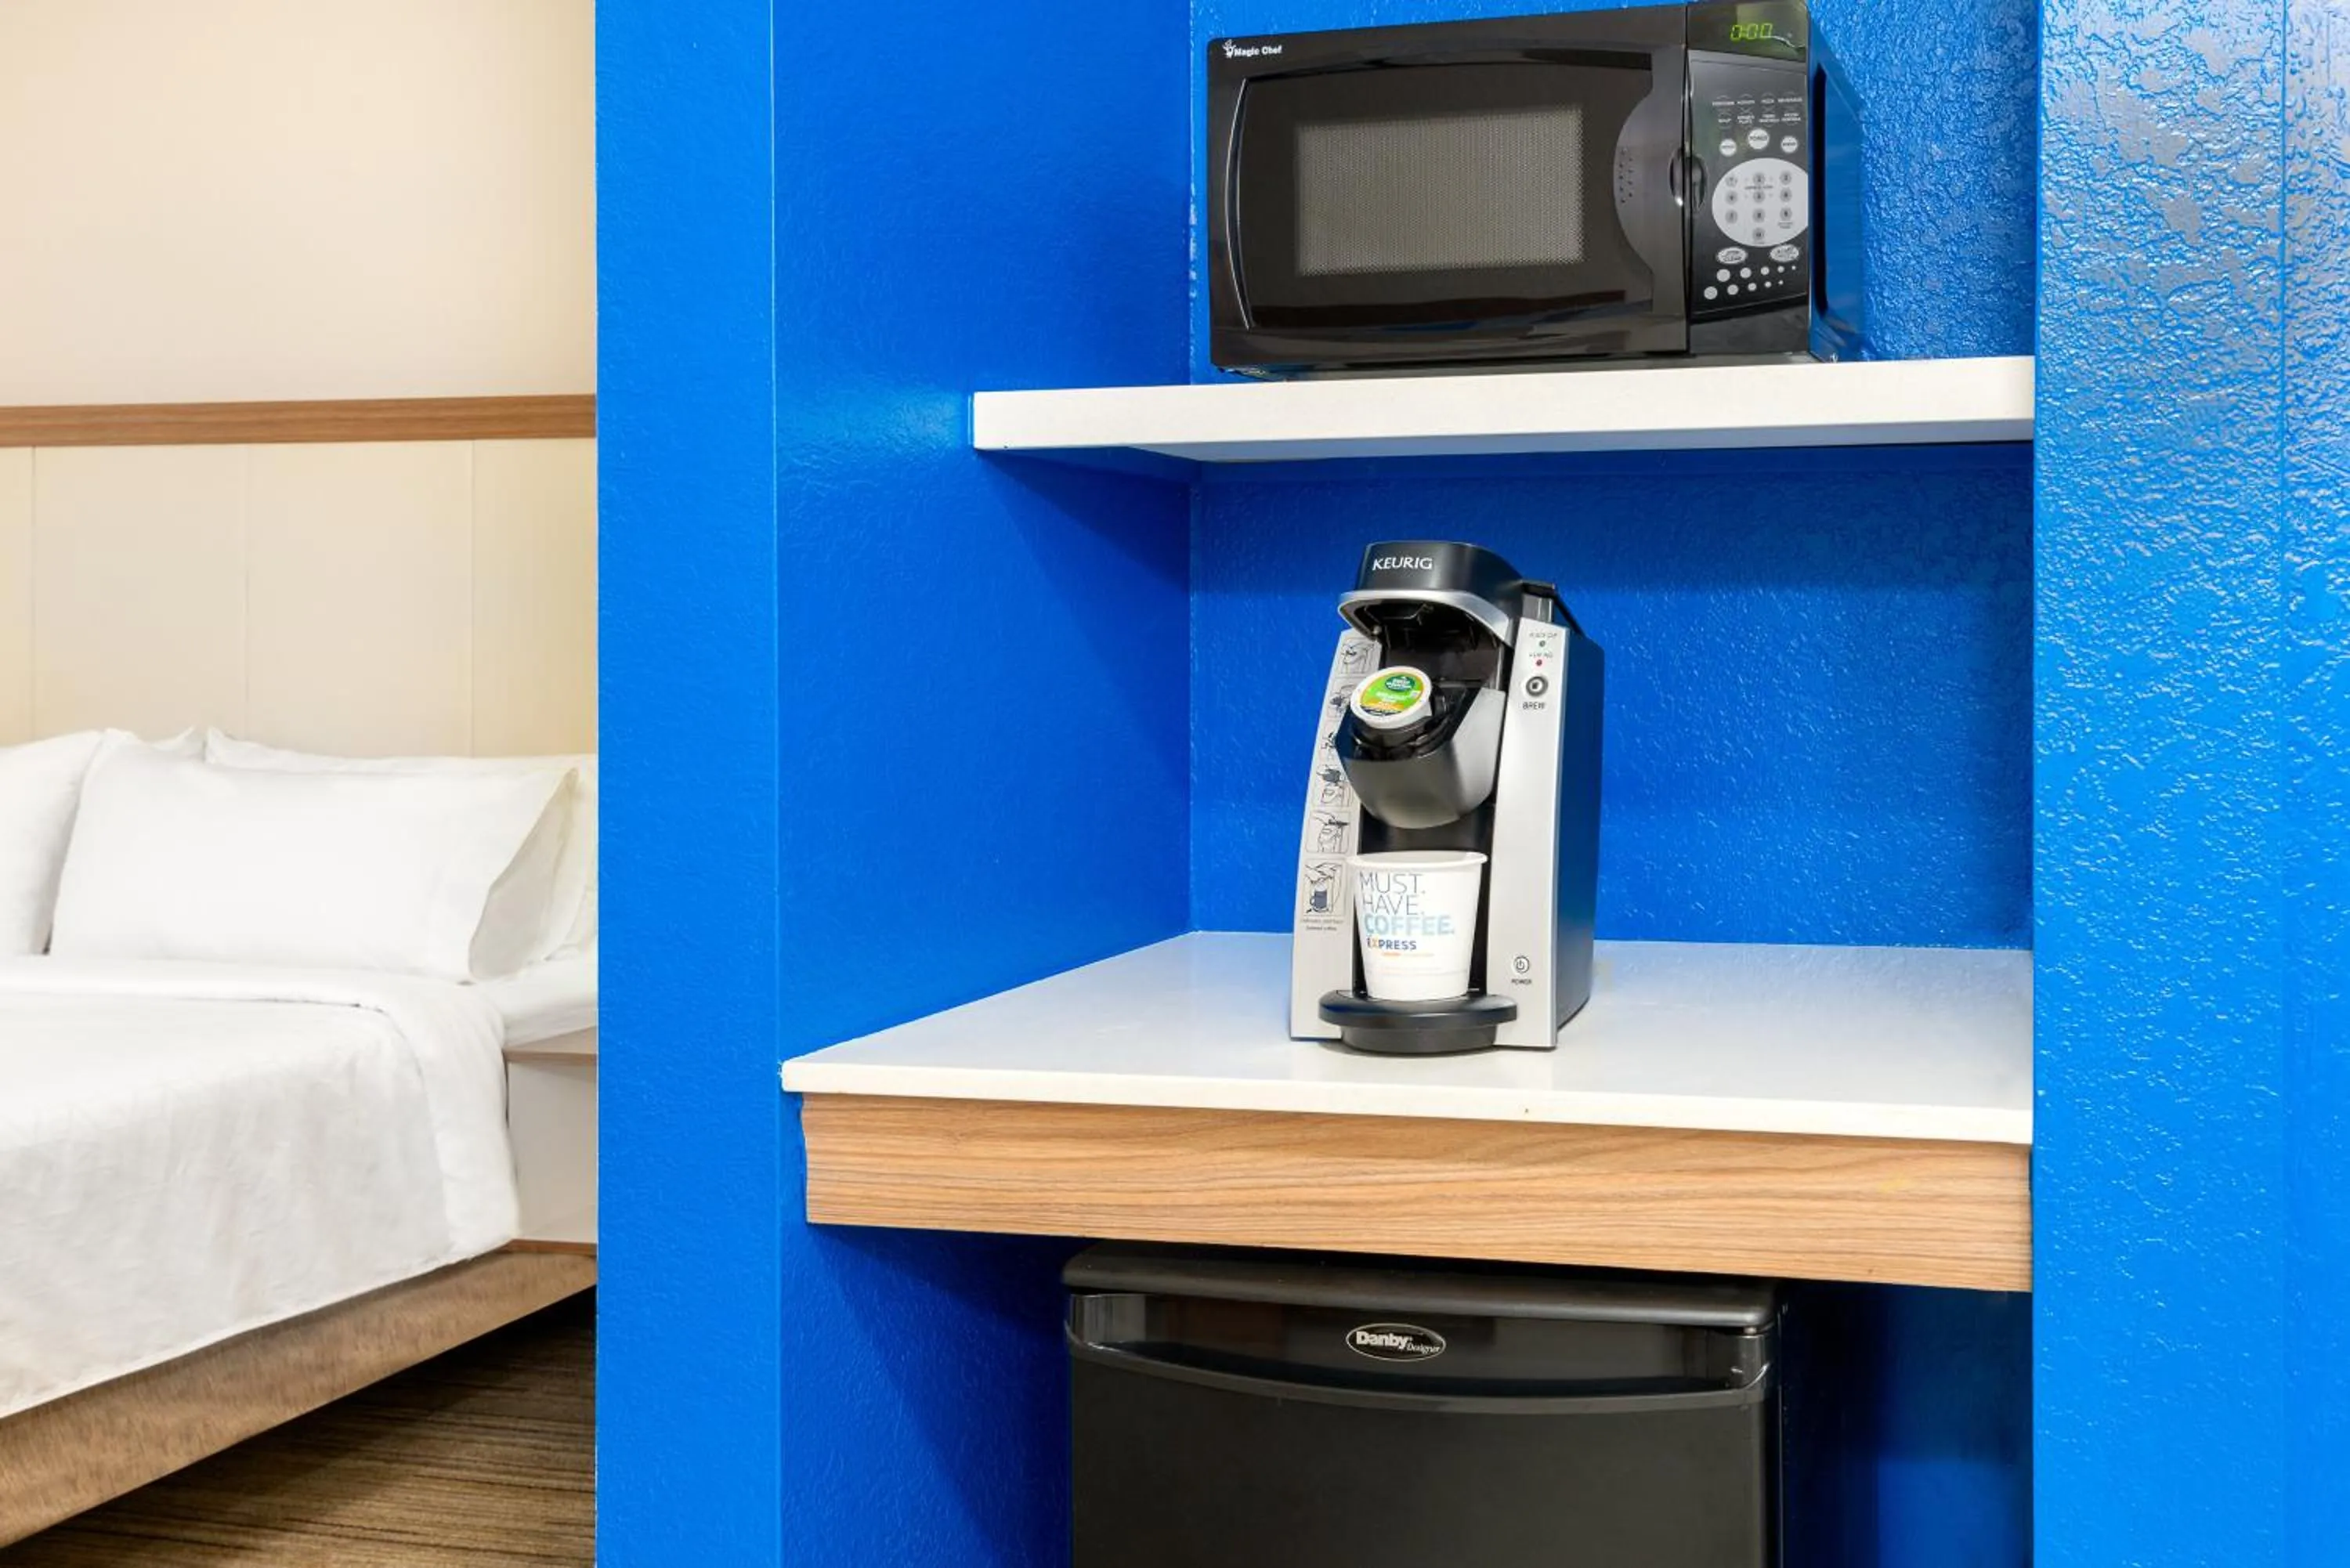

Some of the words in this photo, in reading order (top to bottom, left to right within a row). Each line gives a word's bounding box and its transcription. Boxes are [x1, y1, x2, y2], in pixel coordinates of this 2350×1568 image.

[1234, 46, 1260, 57] Magic
[1261, 45, 1283, 56] Chef
[1372, 556, 1434, 571] KEURIG
[1522, 701, 1546, 710] BREW
[1359, 871, 1426, 894] MUST.
[1362, 894, 1426, 916] HAVE.
[1364, 913, 1455, 936] COFFEE.
[1355, 1331, 1409, 1349] Danby
[1406, 1342, 1441, 1354] Designer
